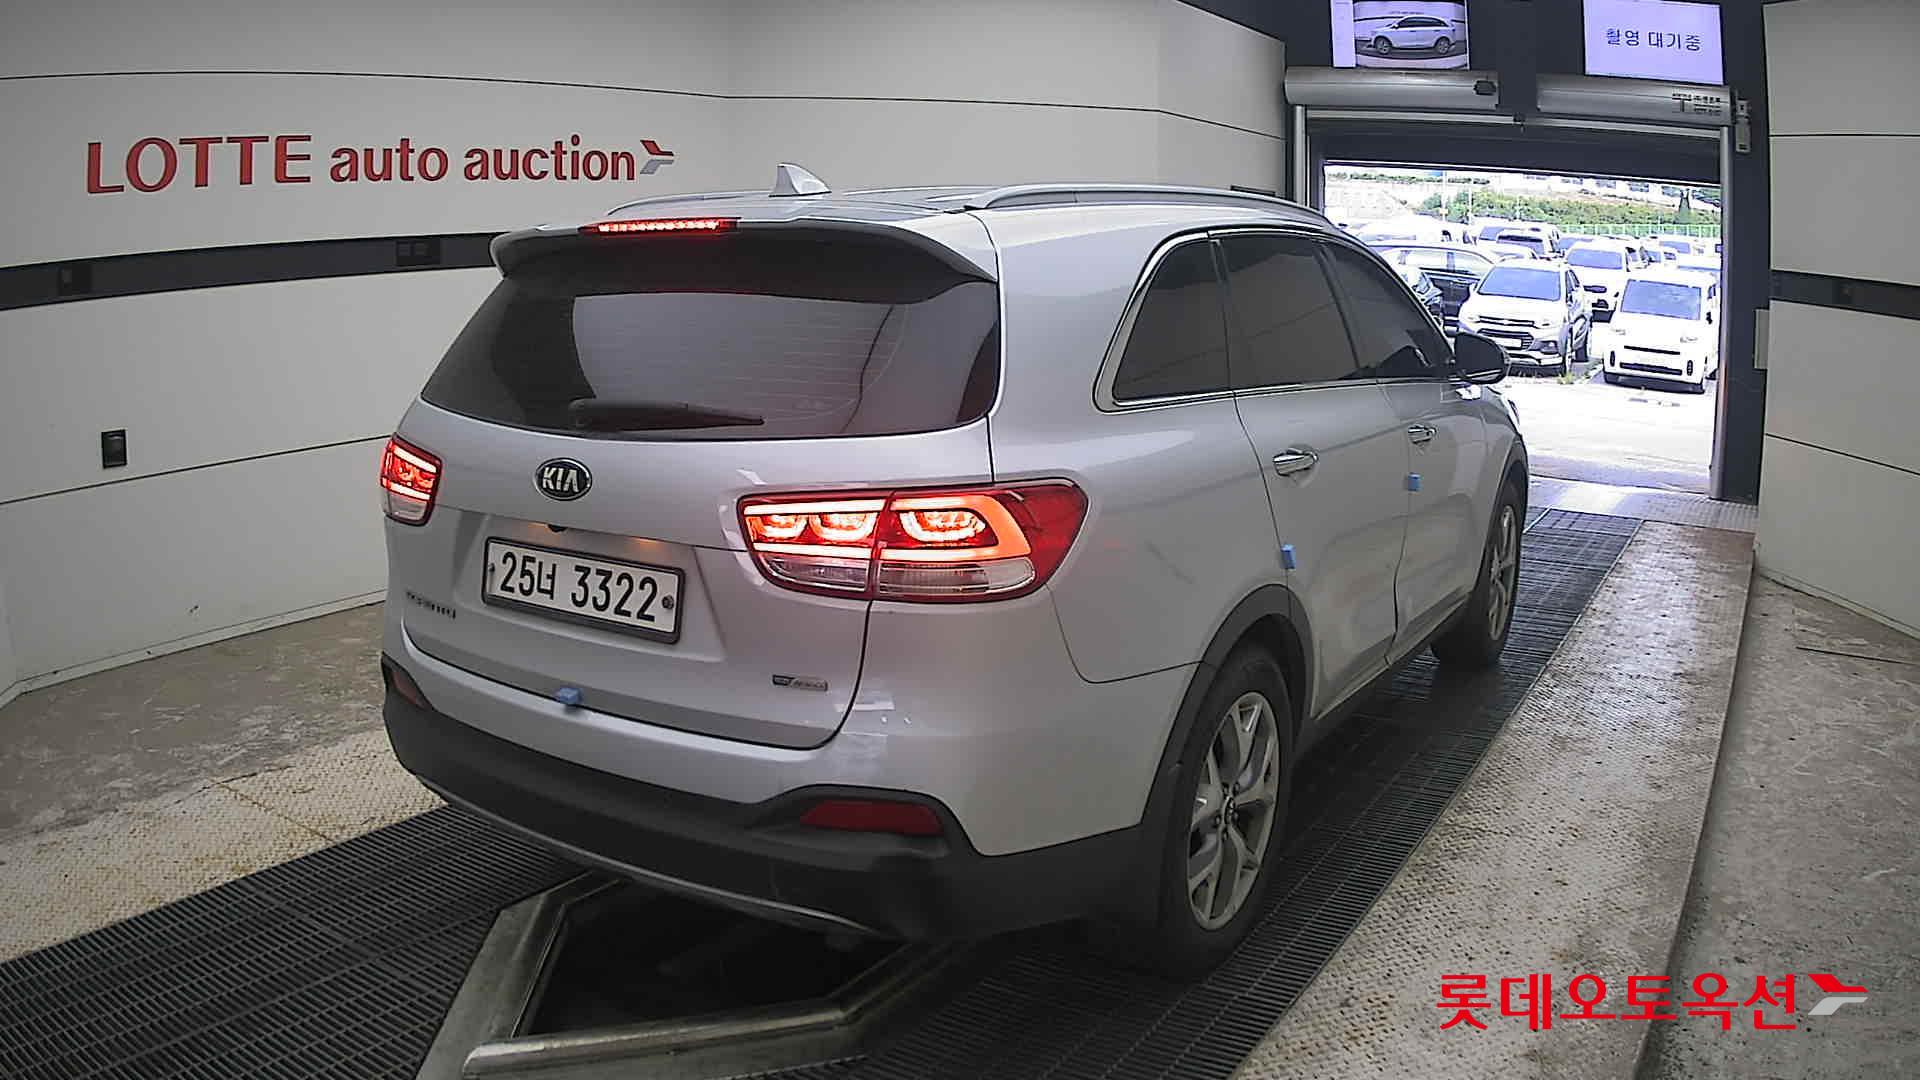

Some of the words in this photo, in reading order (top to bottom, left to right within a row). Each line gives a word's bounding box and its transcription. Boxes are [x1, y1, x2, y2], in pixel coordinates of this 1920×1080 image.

[1648, 31, 1701, 51] 대기중
[87, 135, 311, 194] LOTTE
[330, 137, 448, 183] auto
[464, 134, 635, 181] auction
[542, 467, 579, 493] KIA
[500, 551, 557, 601] 25너
[571, 564, 658, 622] 3322
